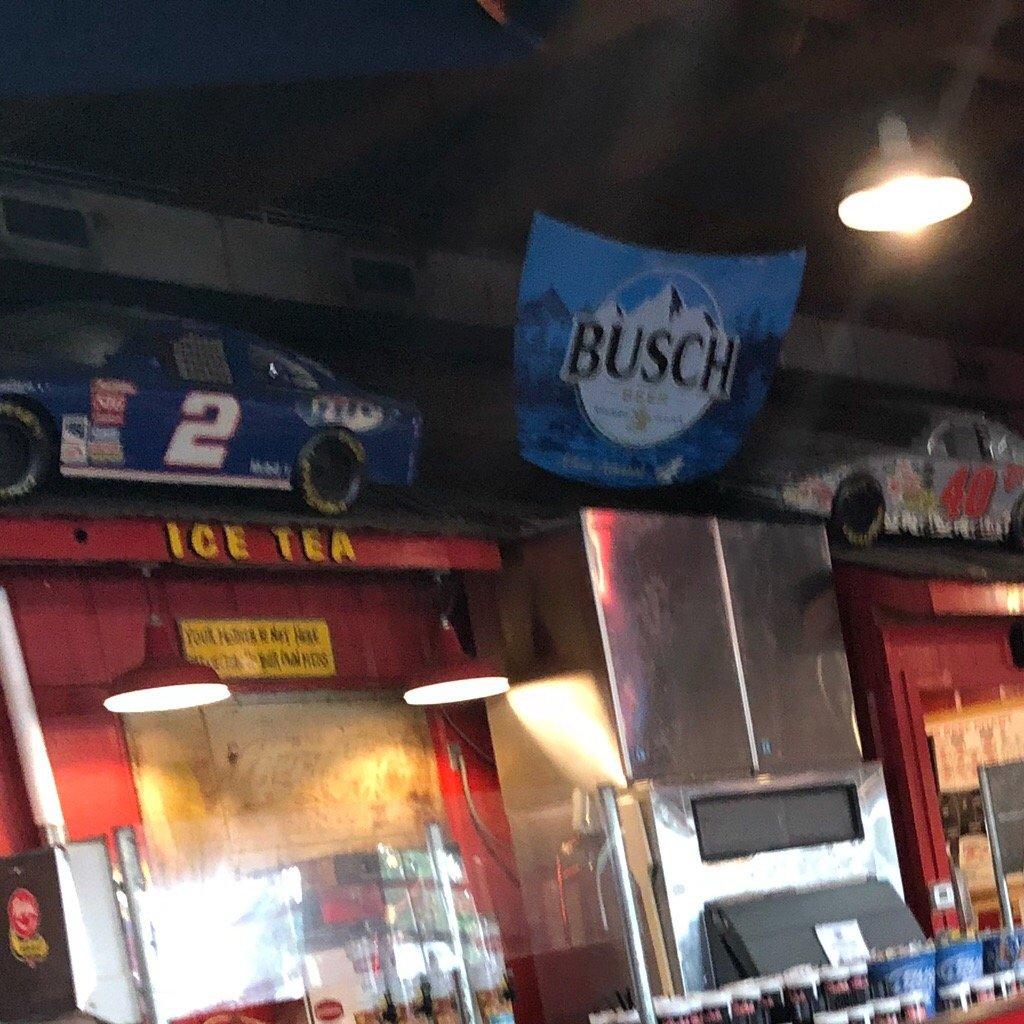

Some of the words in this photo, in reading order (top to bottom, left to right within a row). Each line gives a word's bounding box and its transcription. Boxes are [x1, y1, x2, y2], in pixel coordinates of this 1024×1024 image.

[566, 318, 738, 395] BUSCH
[163, 389, 242, 470] 2
[939, 465, 998, 520] 40
[166, 520, 250, 560] ICE
[271, 524, 356, 564] TEA
